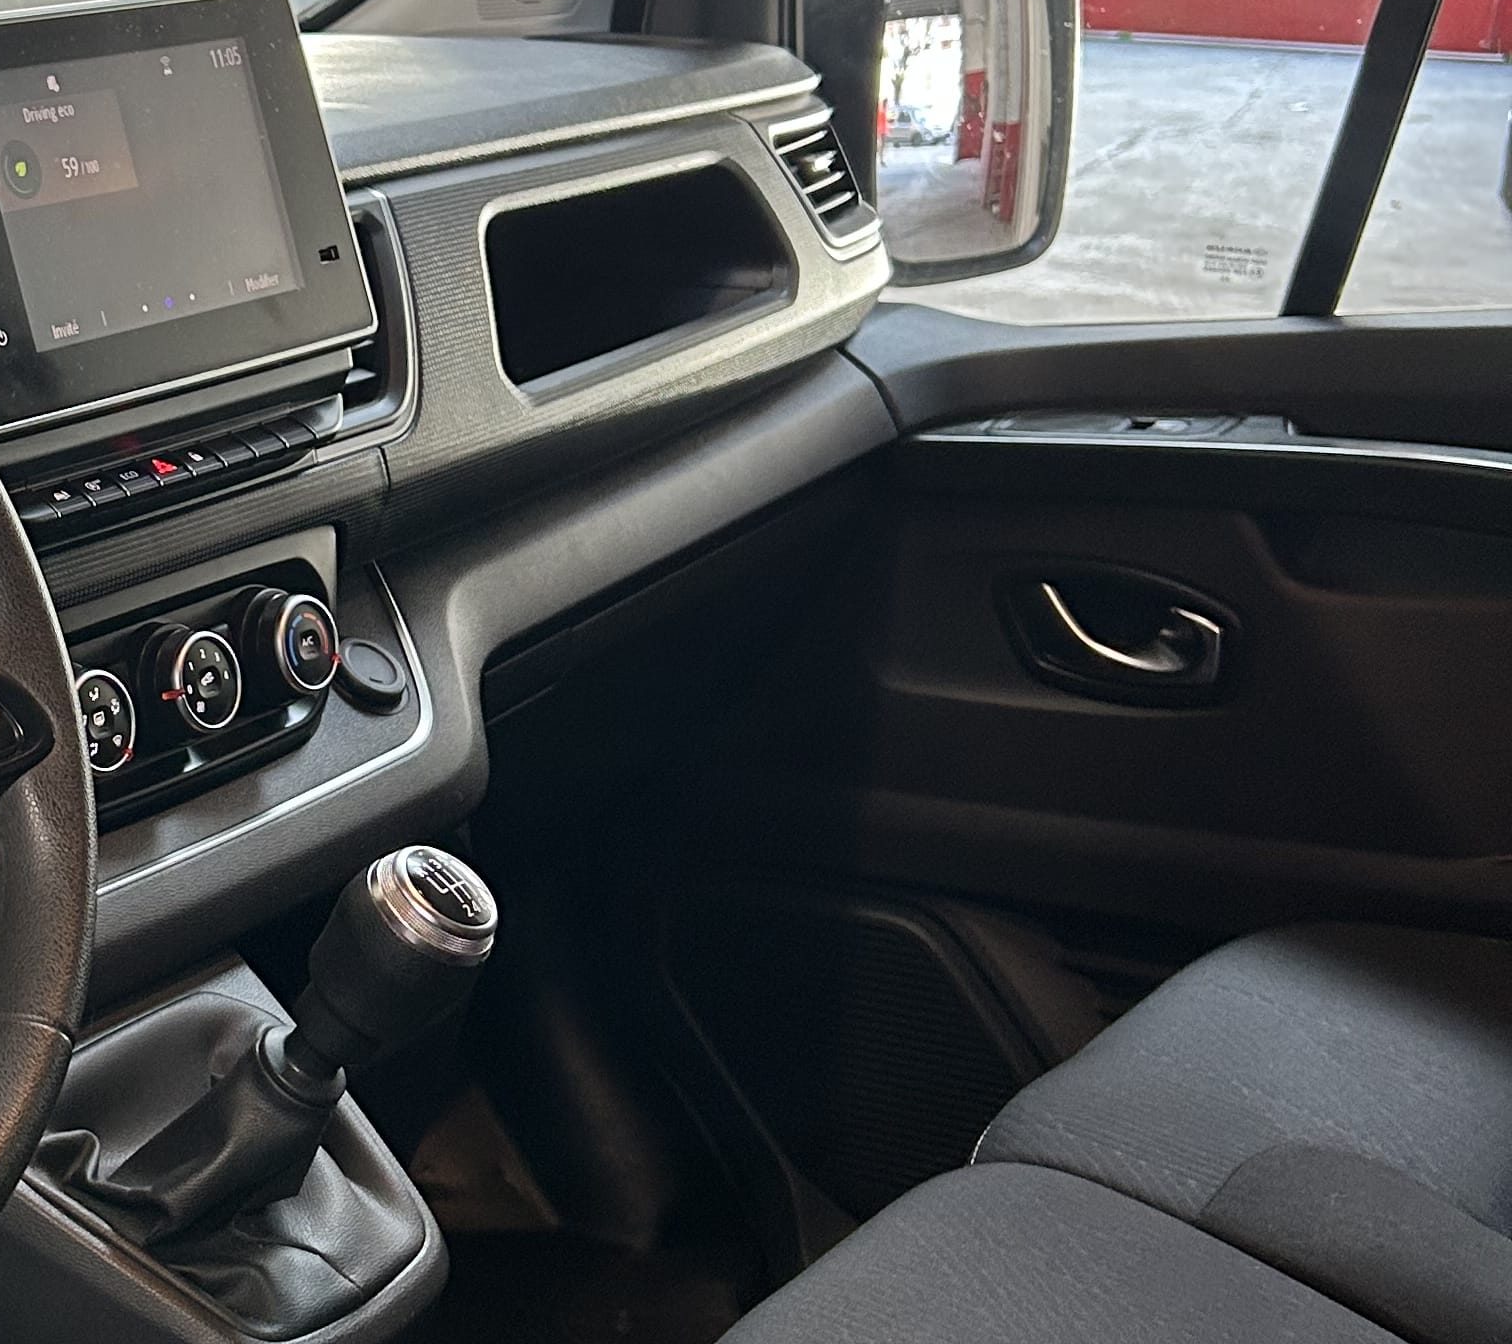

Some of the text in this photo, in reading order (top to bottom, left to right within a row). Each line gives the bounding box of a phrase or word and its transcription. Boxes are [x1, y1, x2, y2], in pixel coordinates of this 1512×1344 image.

[209, 46, 242, 69] 11:05
[22, 104, 75, 123] Driving eco
[51, 318, 80, 340] Invité
[119, 470, 139, 481] ECO
[461, 903, 475, 918] 2
